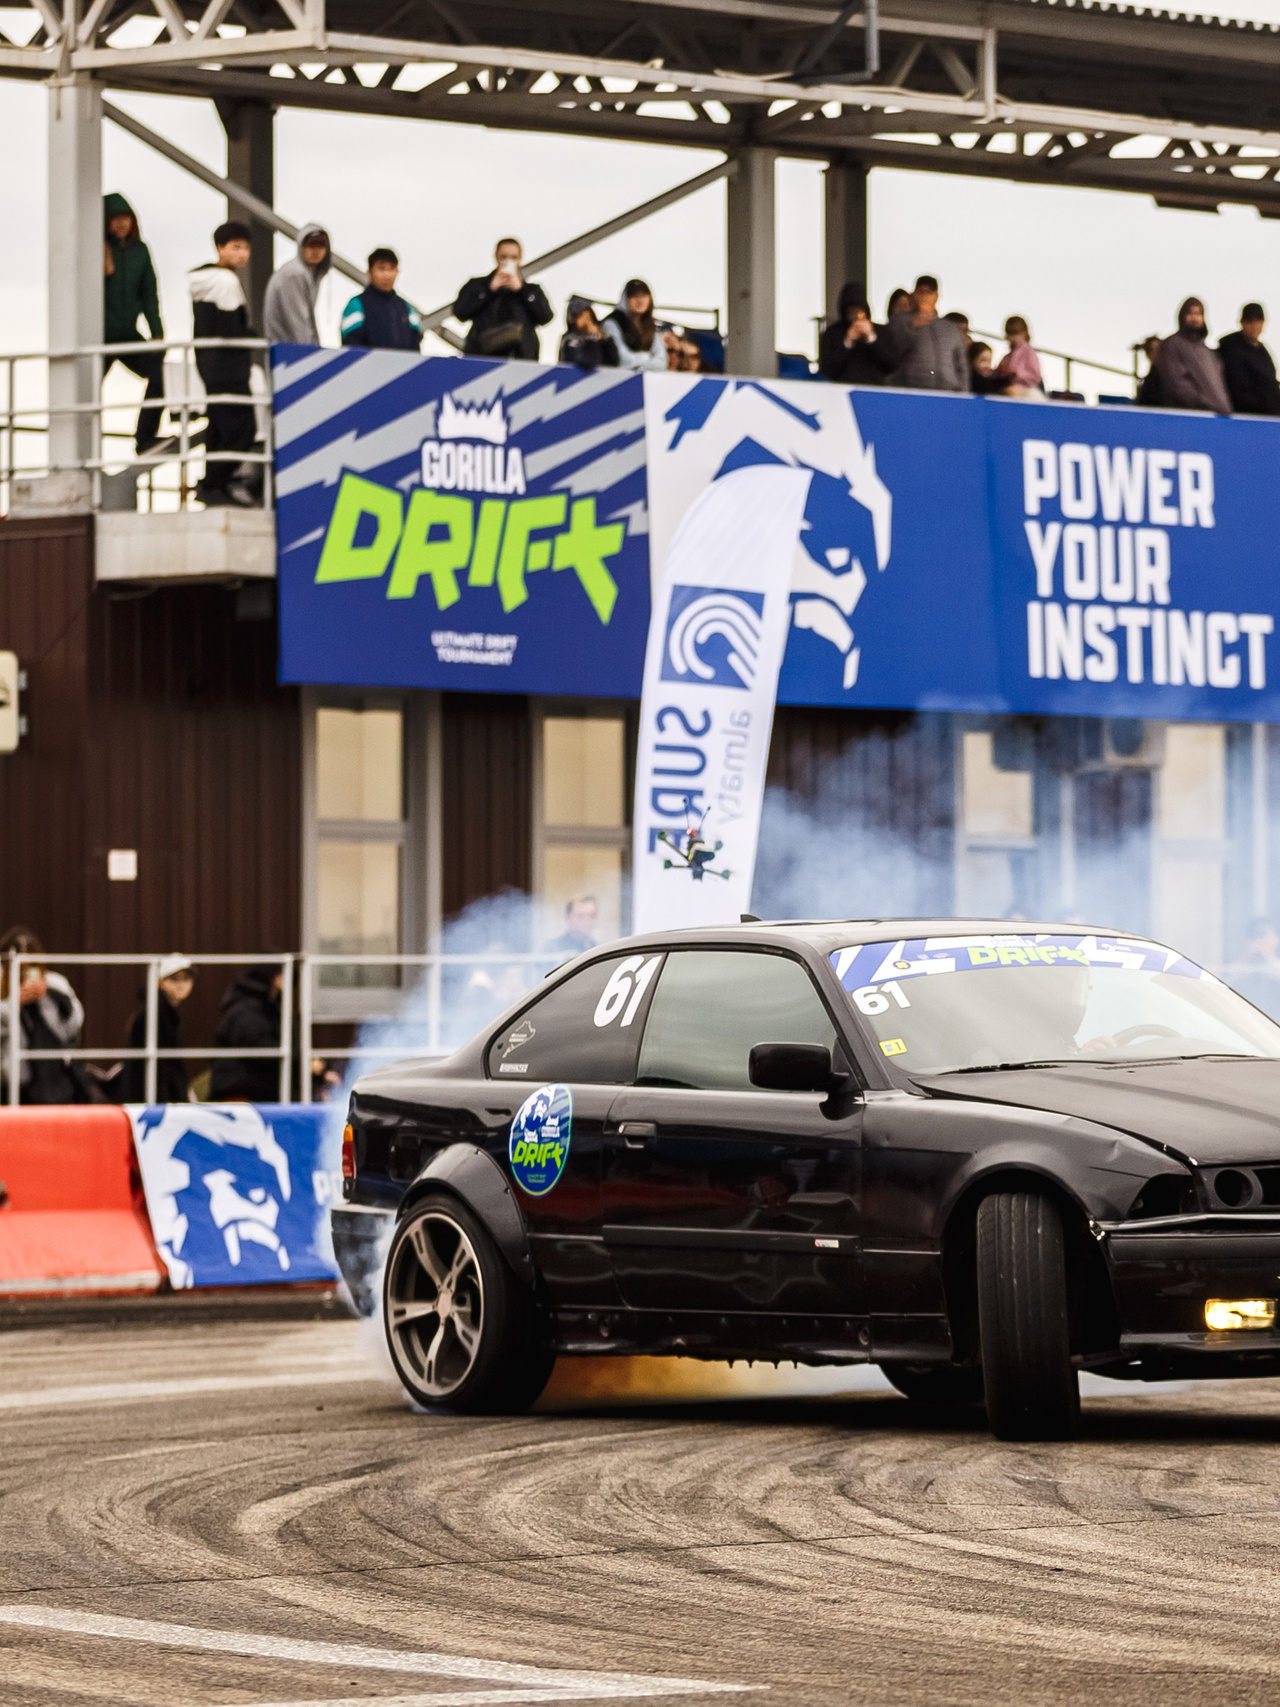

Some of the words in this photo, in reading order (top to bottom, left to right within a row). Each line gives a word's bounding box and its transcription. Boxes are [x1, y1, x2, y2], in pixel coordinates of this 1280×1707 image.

[422, 441, 526, 494] GORILLA
[1022, 438, 1216, 528] POWER
[315, 473, 626, 625] DRIFT
[1024, 519, 1172, 605] YOUR
[1027, 600, 1275, 690] INSTINCT
[593, 955, 662, 1028] 61
[967, 945, 1091, 966] DRIFT
[852, 980, 911, 1016] 61
[512, 1140, 565, 1170] DRIFT
